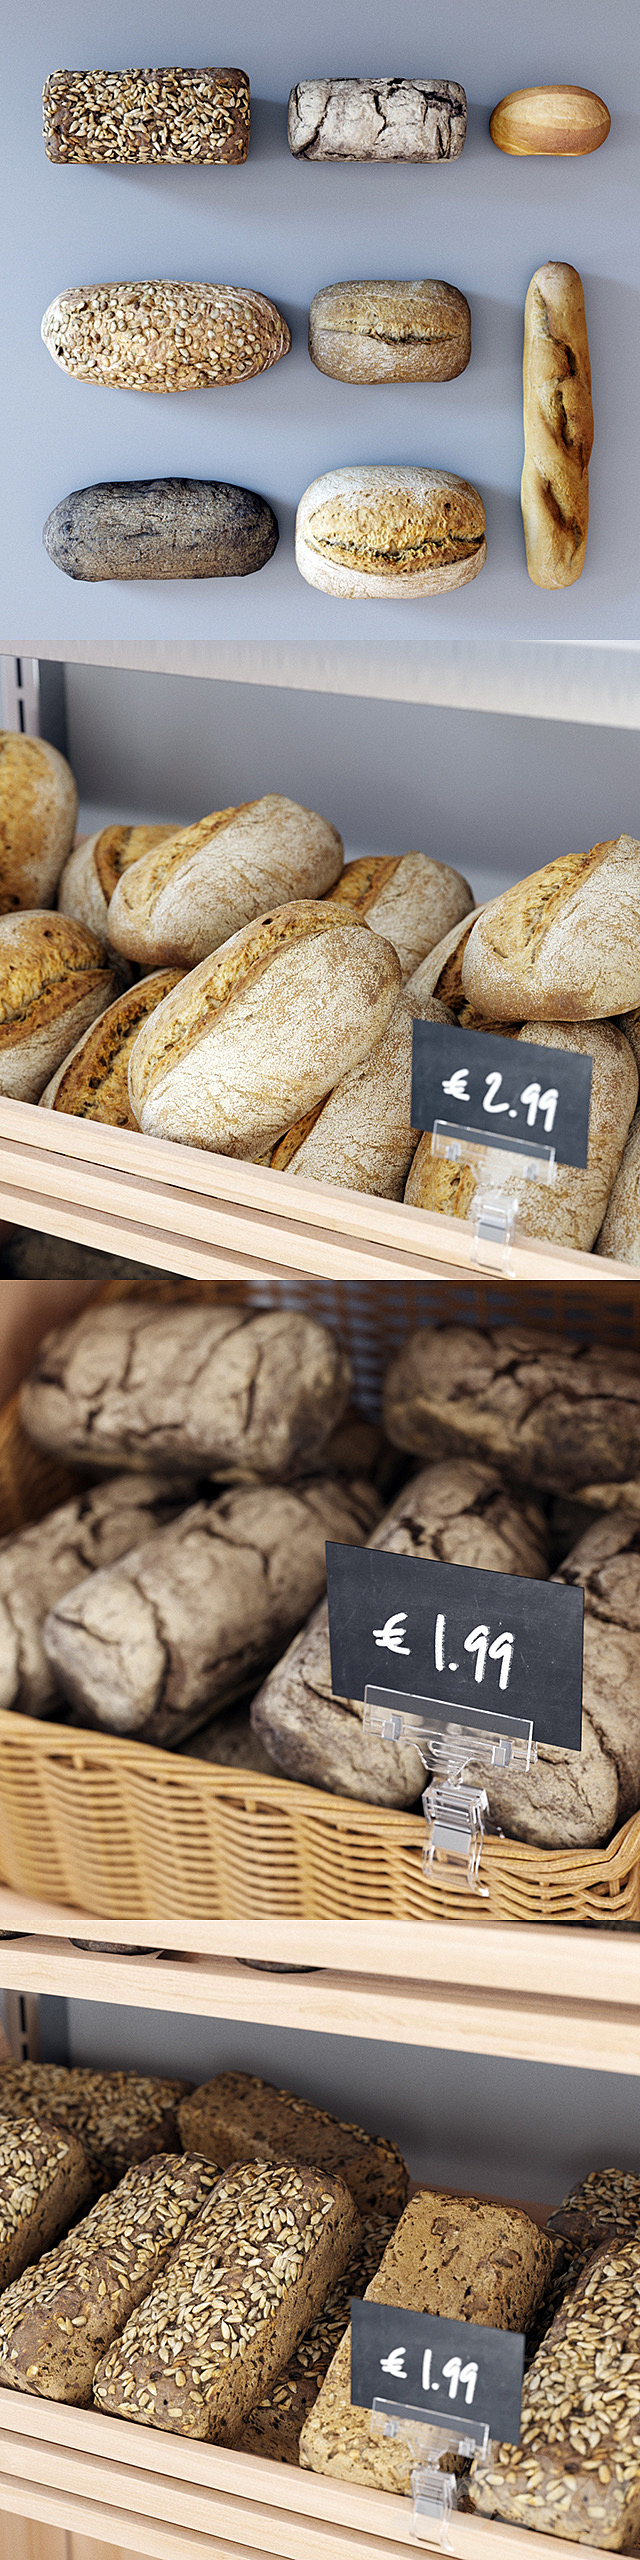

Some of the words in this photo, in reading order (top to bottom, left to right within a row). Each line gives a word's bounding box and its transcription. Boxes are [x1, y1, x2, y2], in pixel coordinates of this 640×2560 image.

[441, 1068, 471, 1102] €
[482, 1071, 560, 1133] 2.99
[372, 1611, 412, 1656] €
[434, 1613, 516, 1691] 1.99
[379, 2346, 408, 2380] €
[421, 2348, 480, 2405] 1.99
